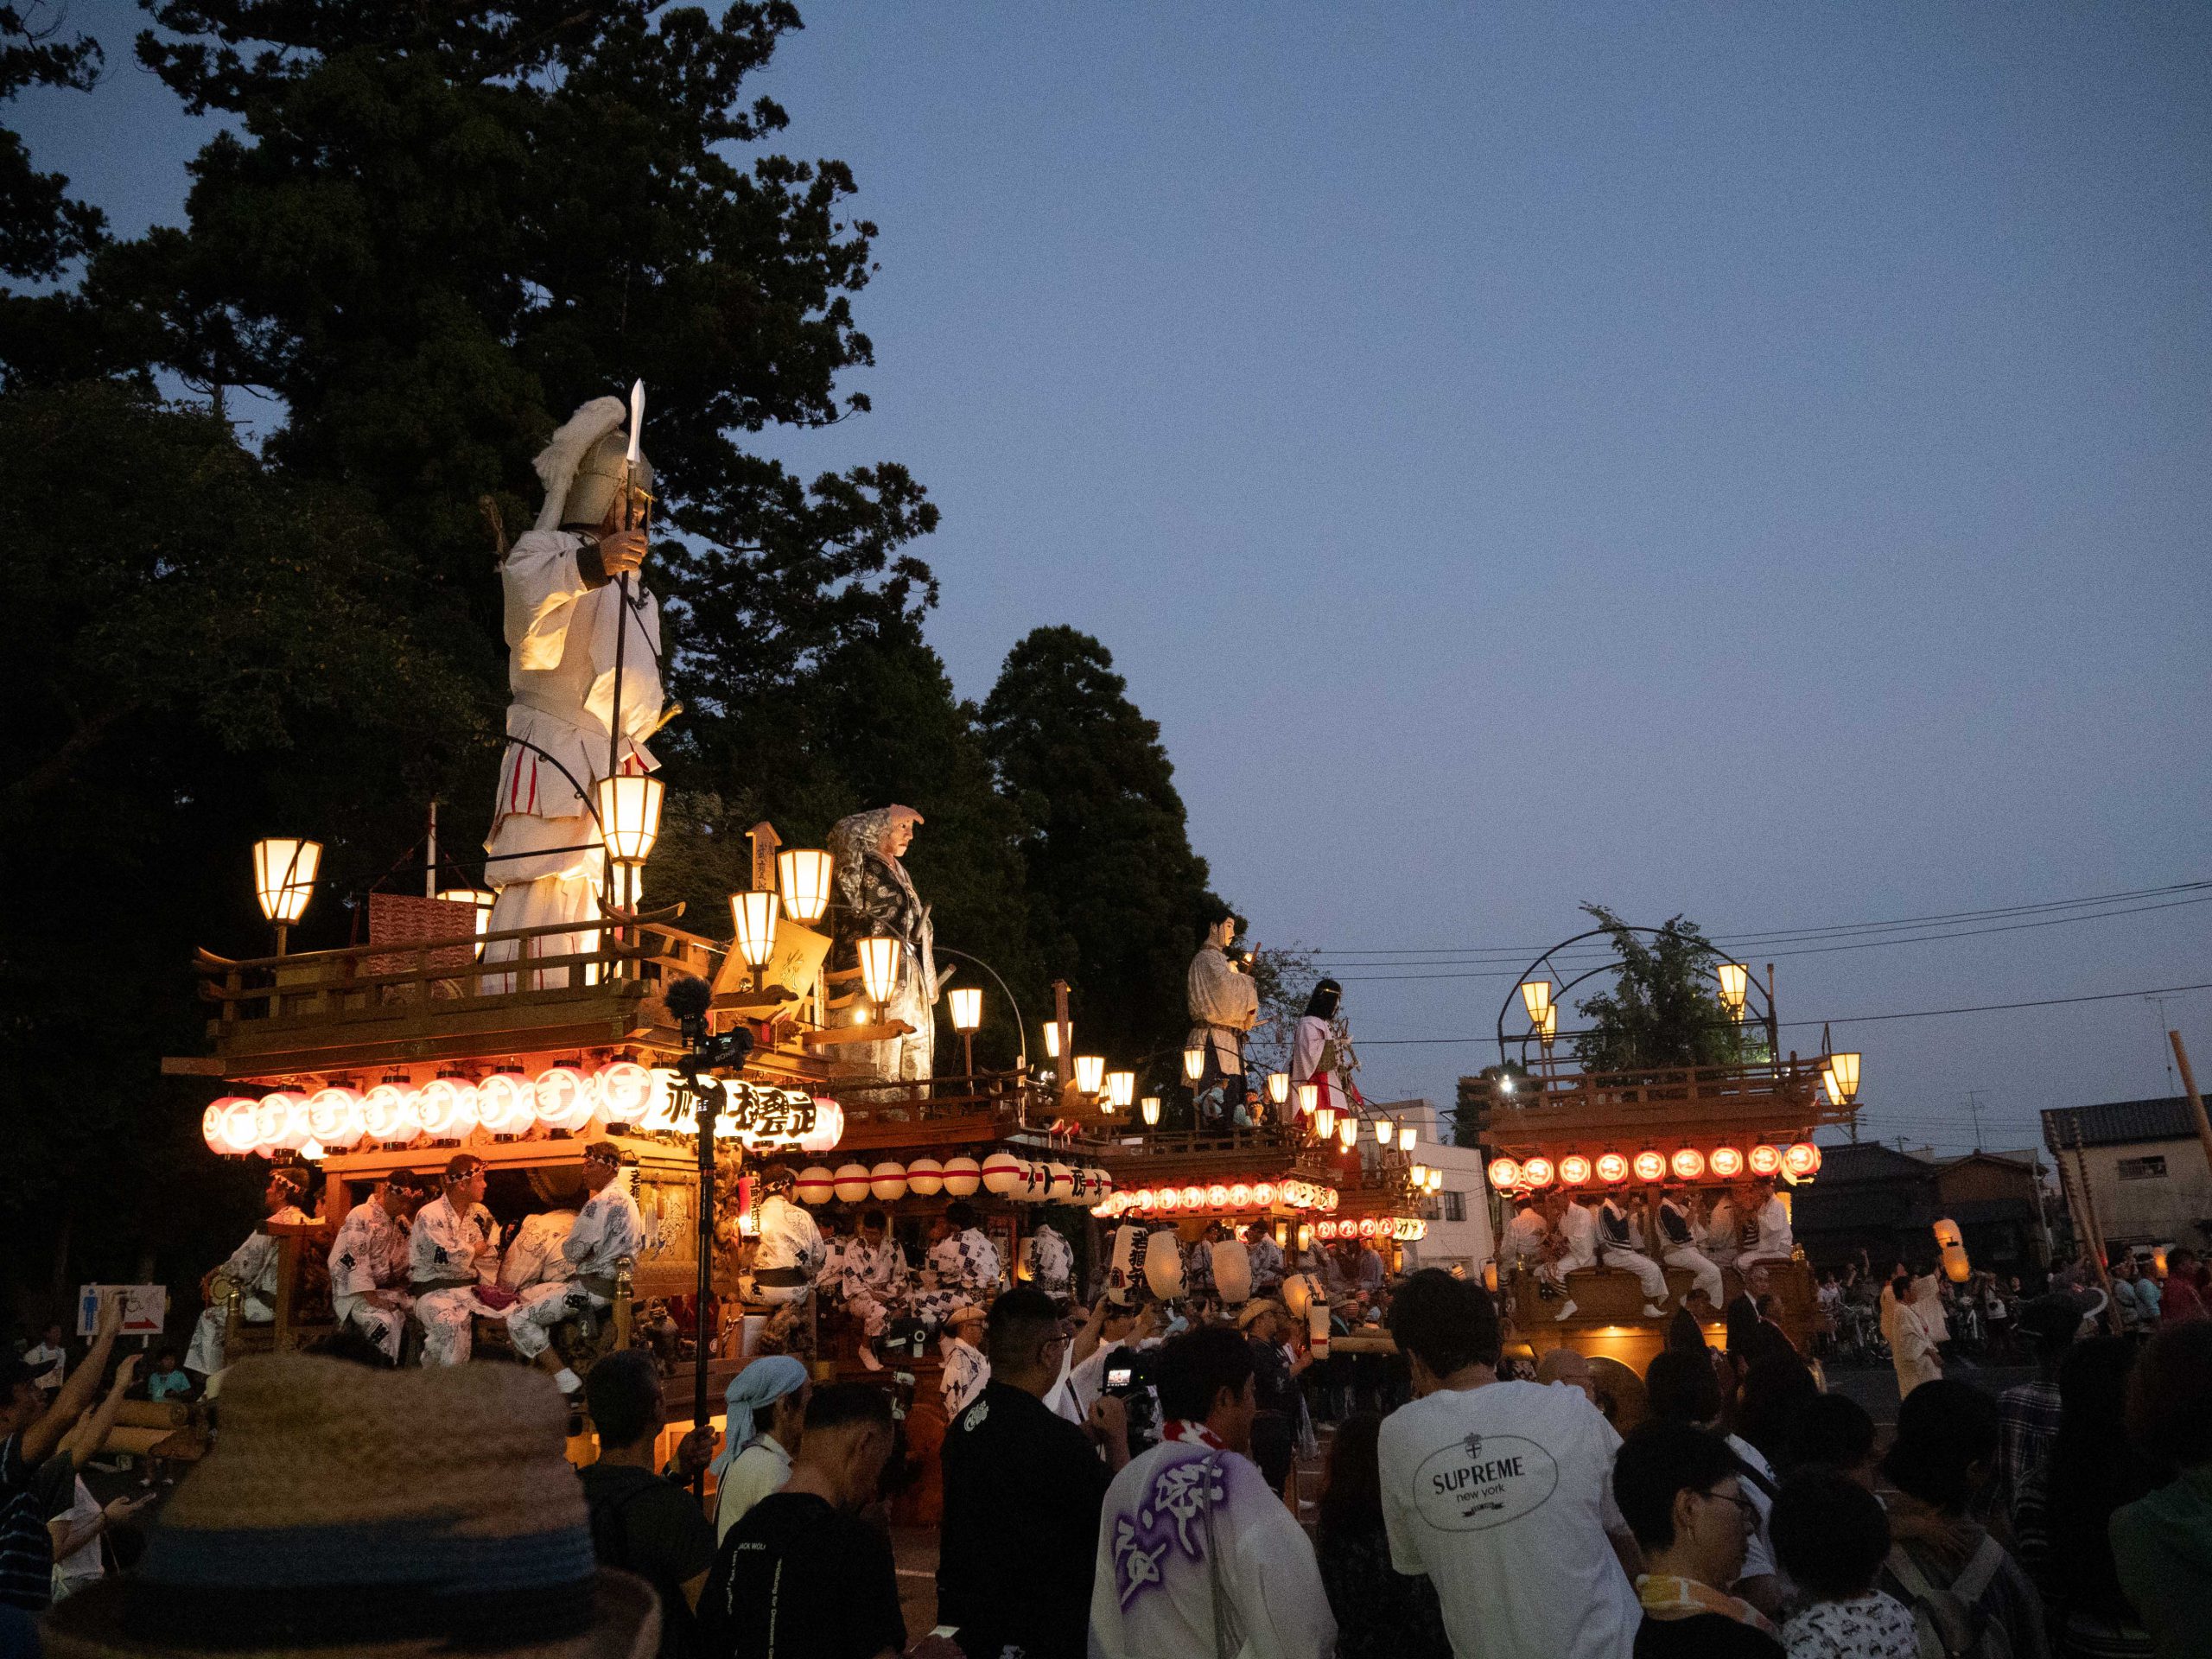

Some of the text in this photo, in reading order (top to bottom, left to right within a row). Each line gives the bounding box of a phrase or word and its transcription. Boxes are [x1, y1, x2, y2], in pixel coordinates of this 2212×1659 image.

[536, 1073, 573, 1115] す
[611, 1066, 650, 1109] す
[1433, 1456, 1526, 1495] SUPREME
[1456, 1483, 1506, 1503] new york
